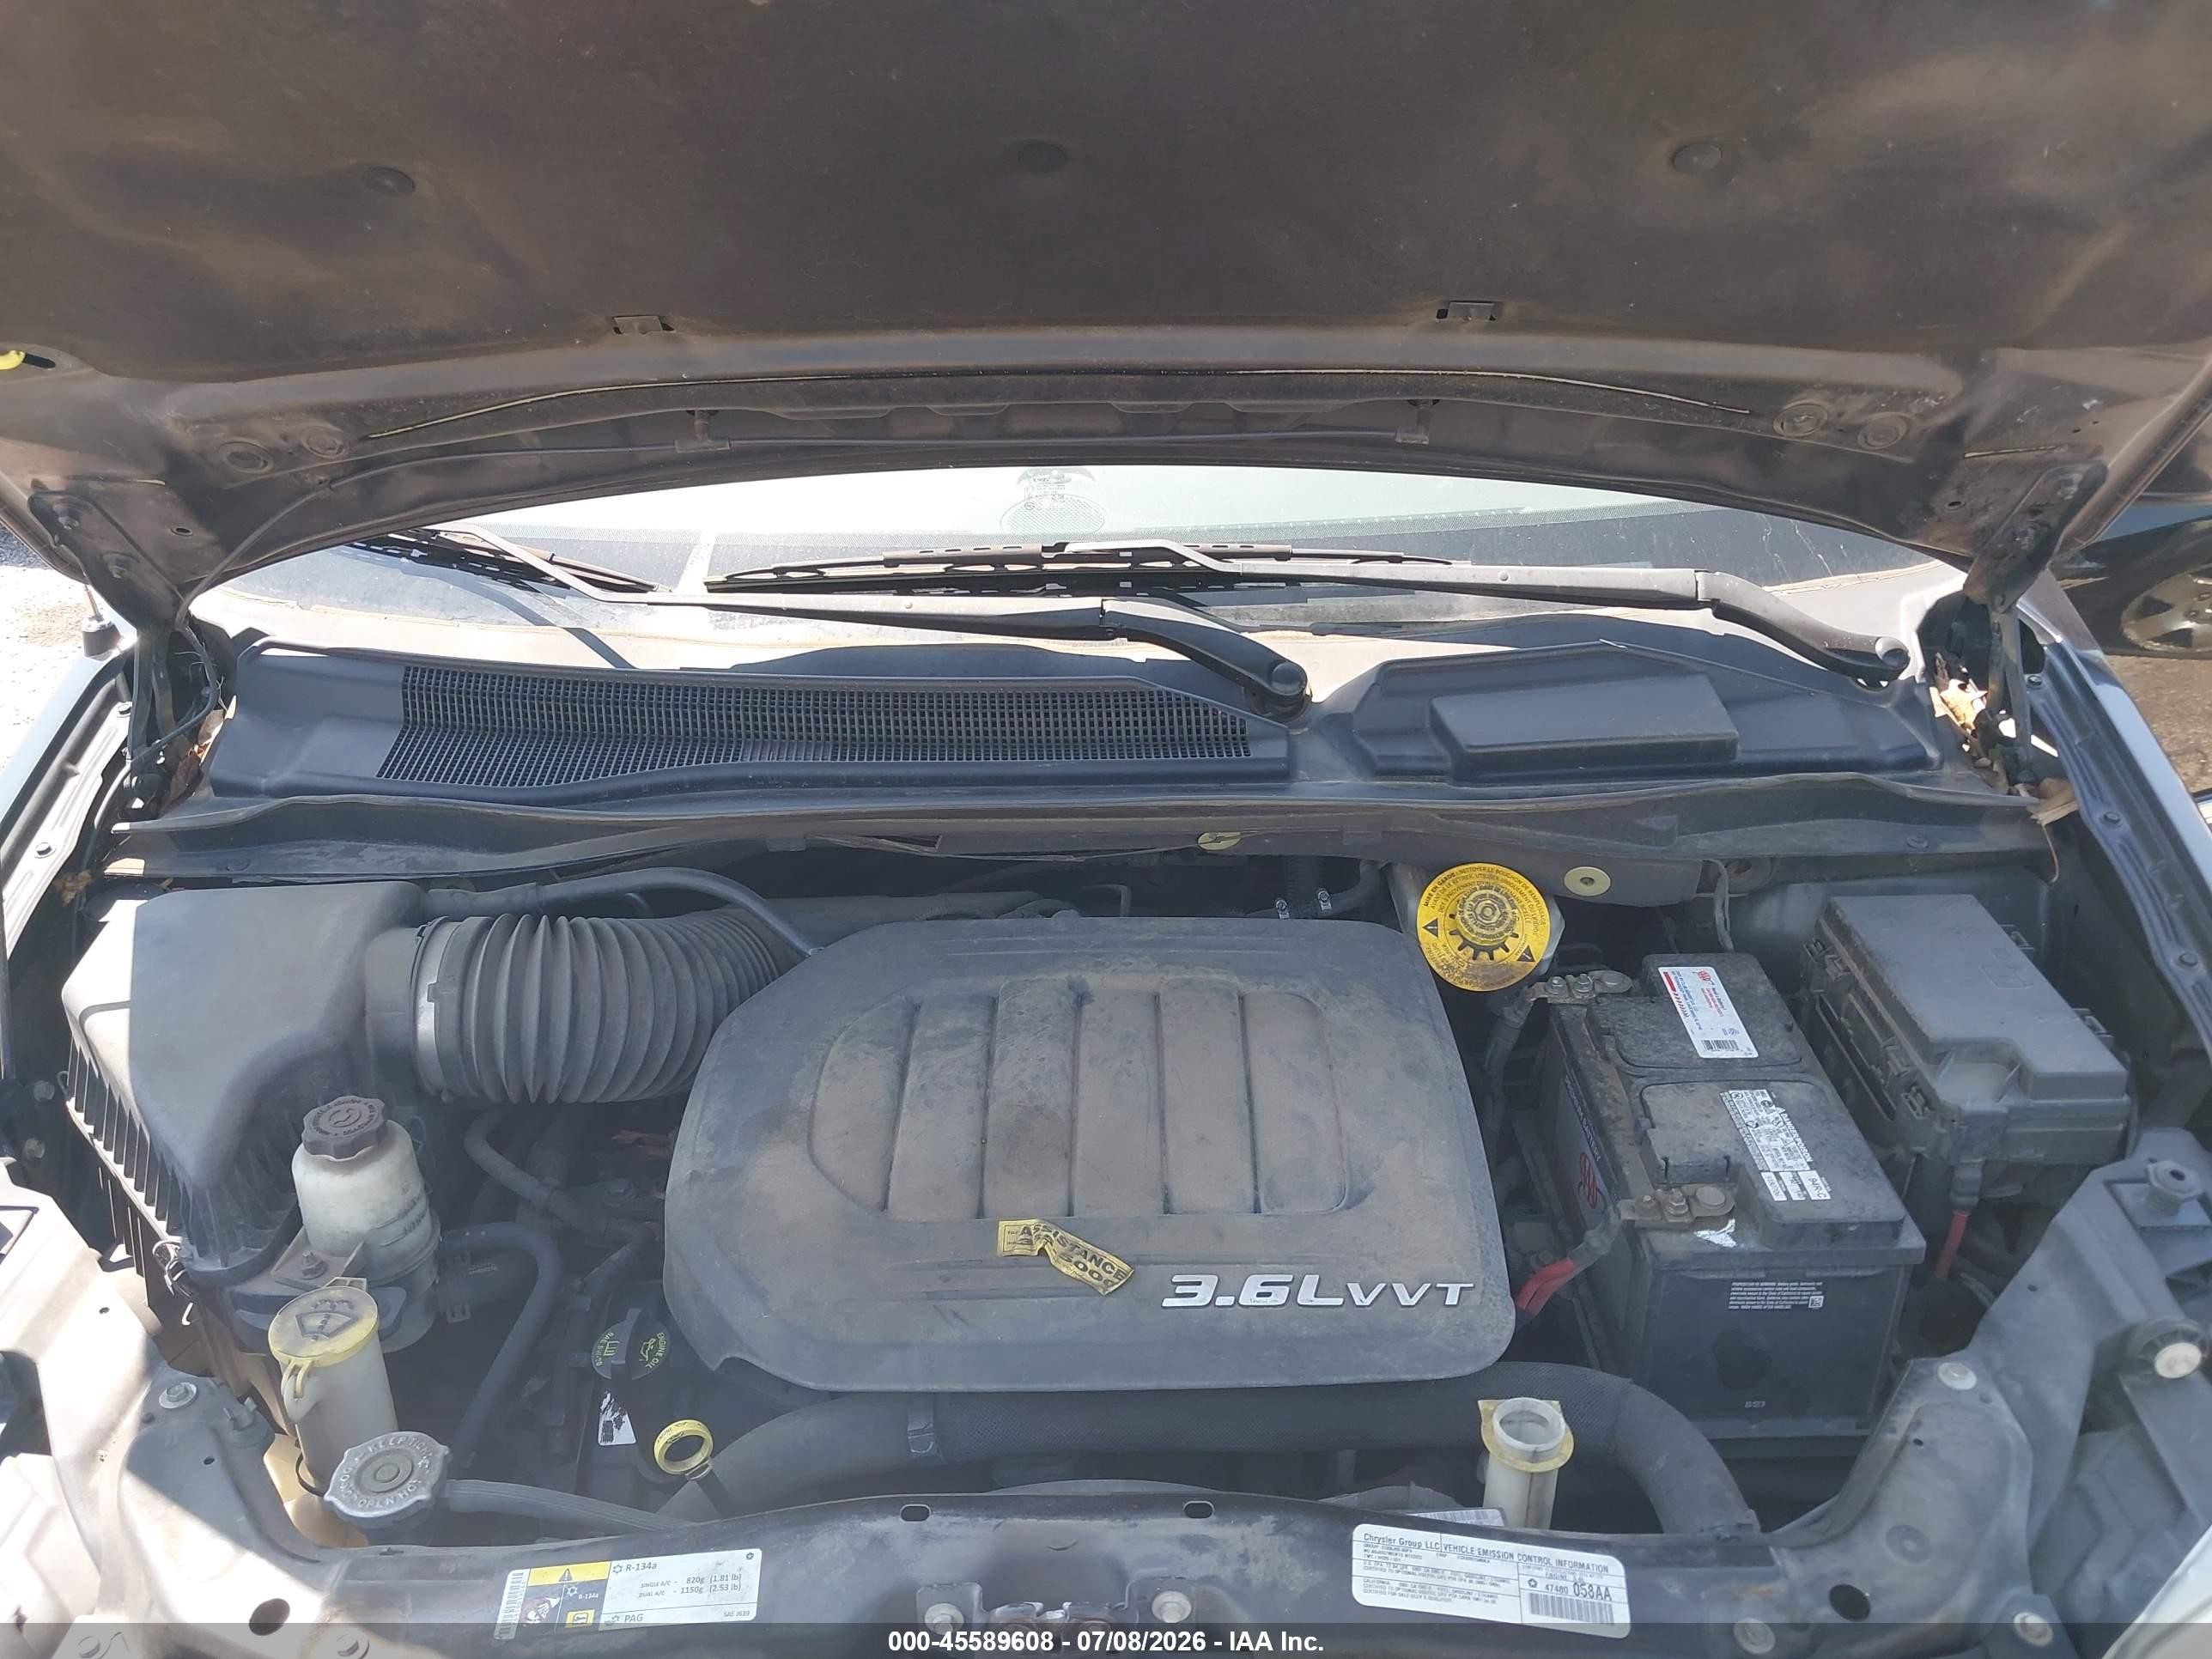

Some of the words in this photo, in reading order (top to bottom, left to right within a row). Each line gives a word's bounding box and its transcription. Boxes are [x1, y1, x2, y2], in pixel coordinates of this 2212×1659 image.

[1019, 1224, 1127, 1280] ASSISTANCE
[657, 1332, 667, 1357] ENGINE
[645, 1357, 659, 1369] OIL
[368, 1436, 407, 1453] KEEP
[357, 1497, 396, 1509] OPEN
[1364, 1533, 1396, 1545] Chrysler
[1399, 1538, 1423, 1550] Group
[1425, 1541, 1440, 1550] LLC
[1443, 1543, 1475, 1555] VEHICLE
[1478, 1547, 1515, 1560] EMISSION
[1517, 1553, 1553, 1566] CONTROL
[1555, 1559, 1609, 1574] INFORMATION
[625, 1562, 658, 1572] R-134a
[686, 1577, 705, 1585] 820g
[709, 1574, 729, 1583] (1.81
[731, 1573, 742, 1582] lb)
[681, 1586, 704, 1595] 1150g
[709, 1583, 729, 1593] (2.53
[731, 1583, 742, 1591] lb)
[1573, 1582, 1613, 1602] 058AA
[624, 1613, 644, 1623] PAG
